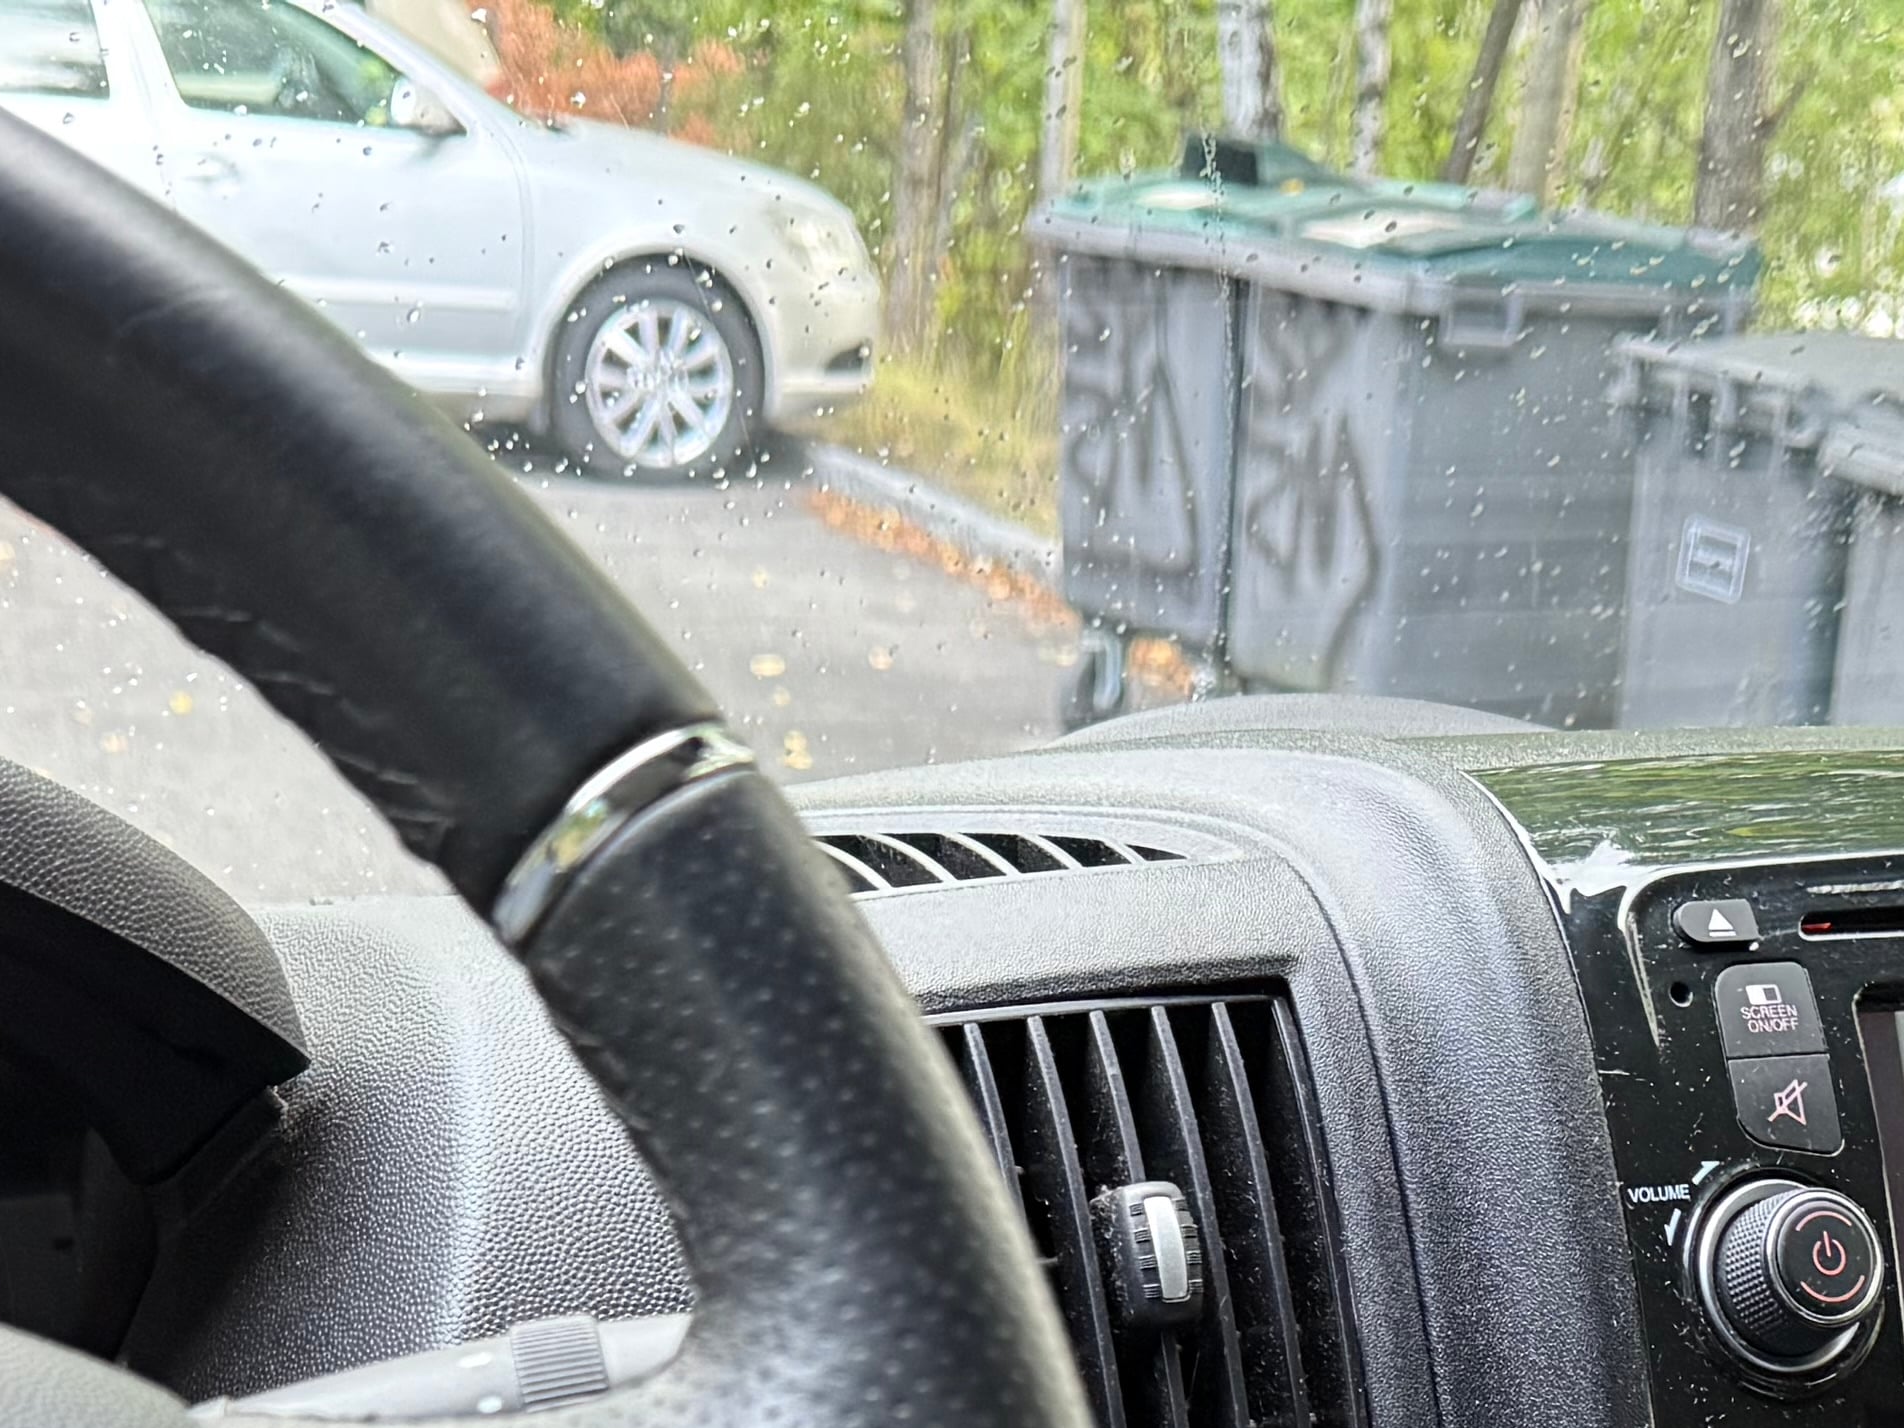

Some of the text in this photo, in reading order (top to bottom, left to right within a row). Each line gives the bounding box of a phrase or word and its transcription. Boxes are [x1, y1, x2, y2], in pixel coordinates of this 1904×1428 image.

[1740, 1004, 1798, 1020] SCREEN
[1747, 1017, 1799, 1033] ON/OFF
[1628, 1182, 1691, 1204] VOLUME
